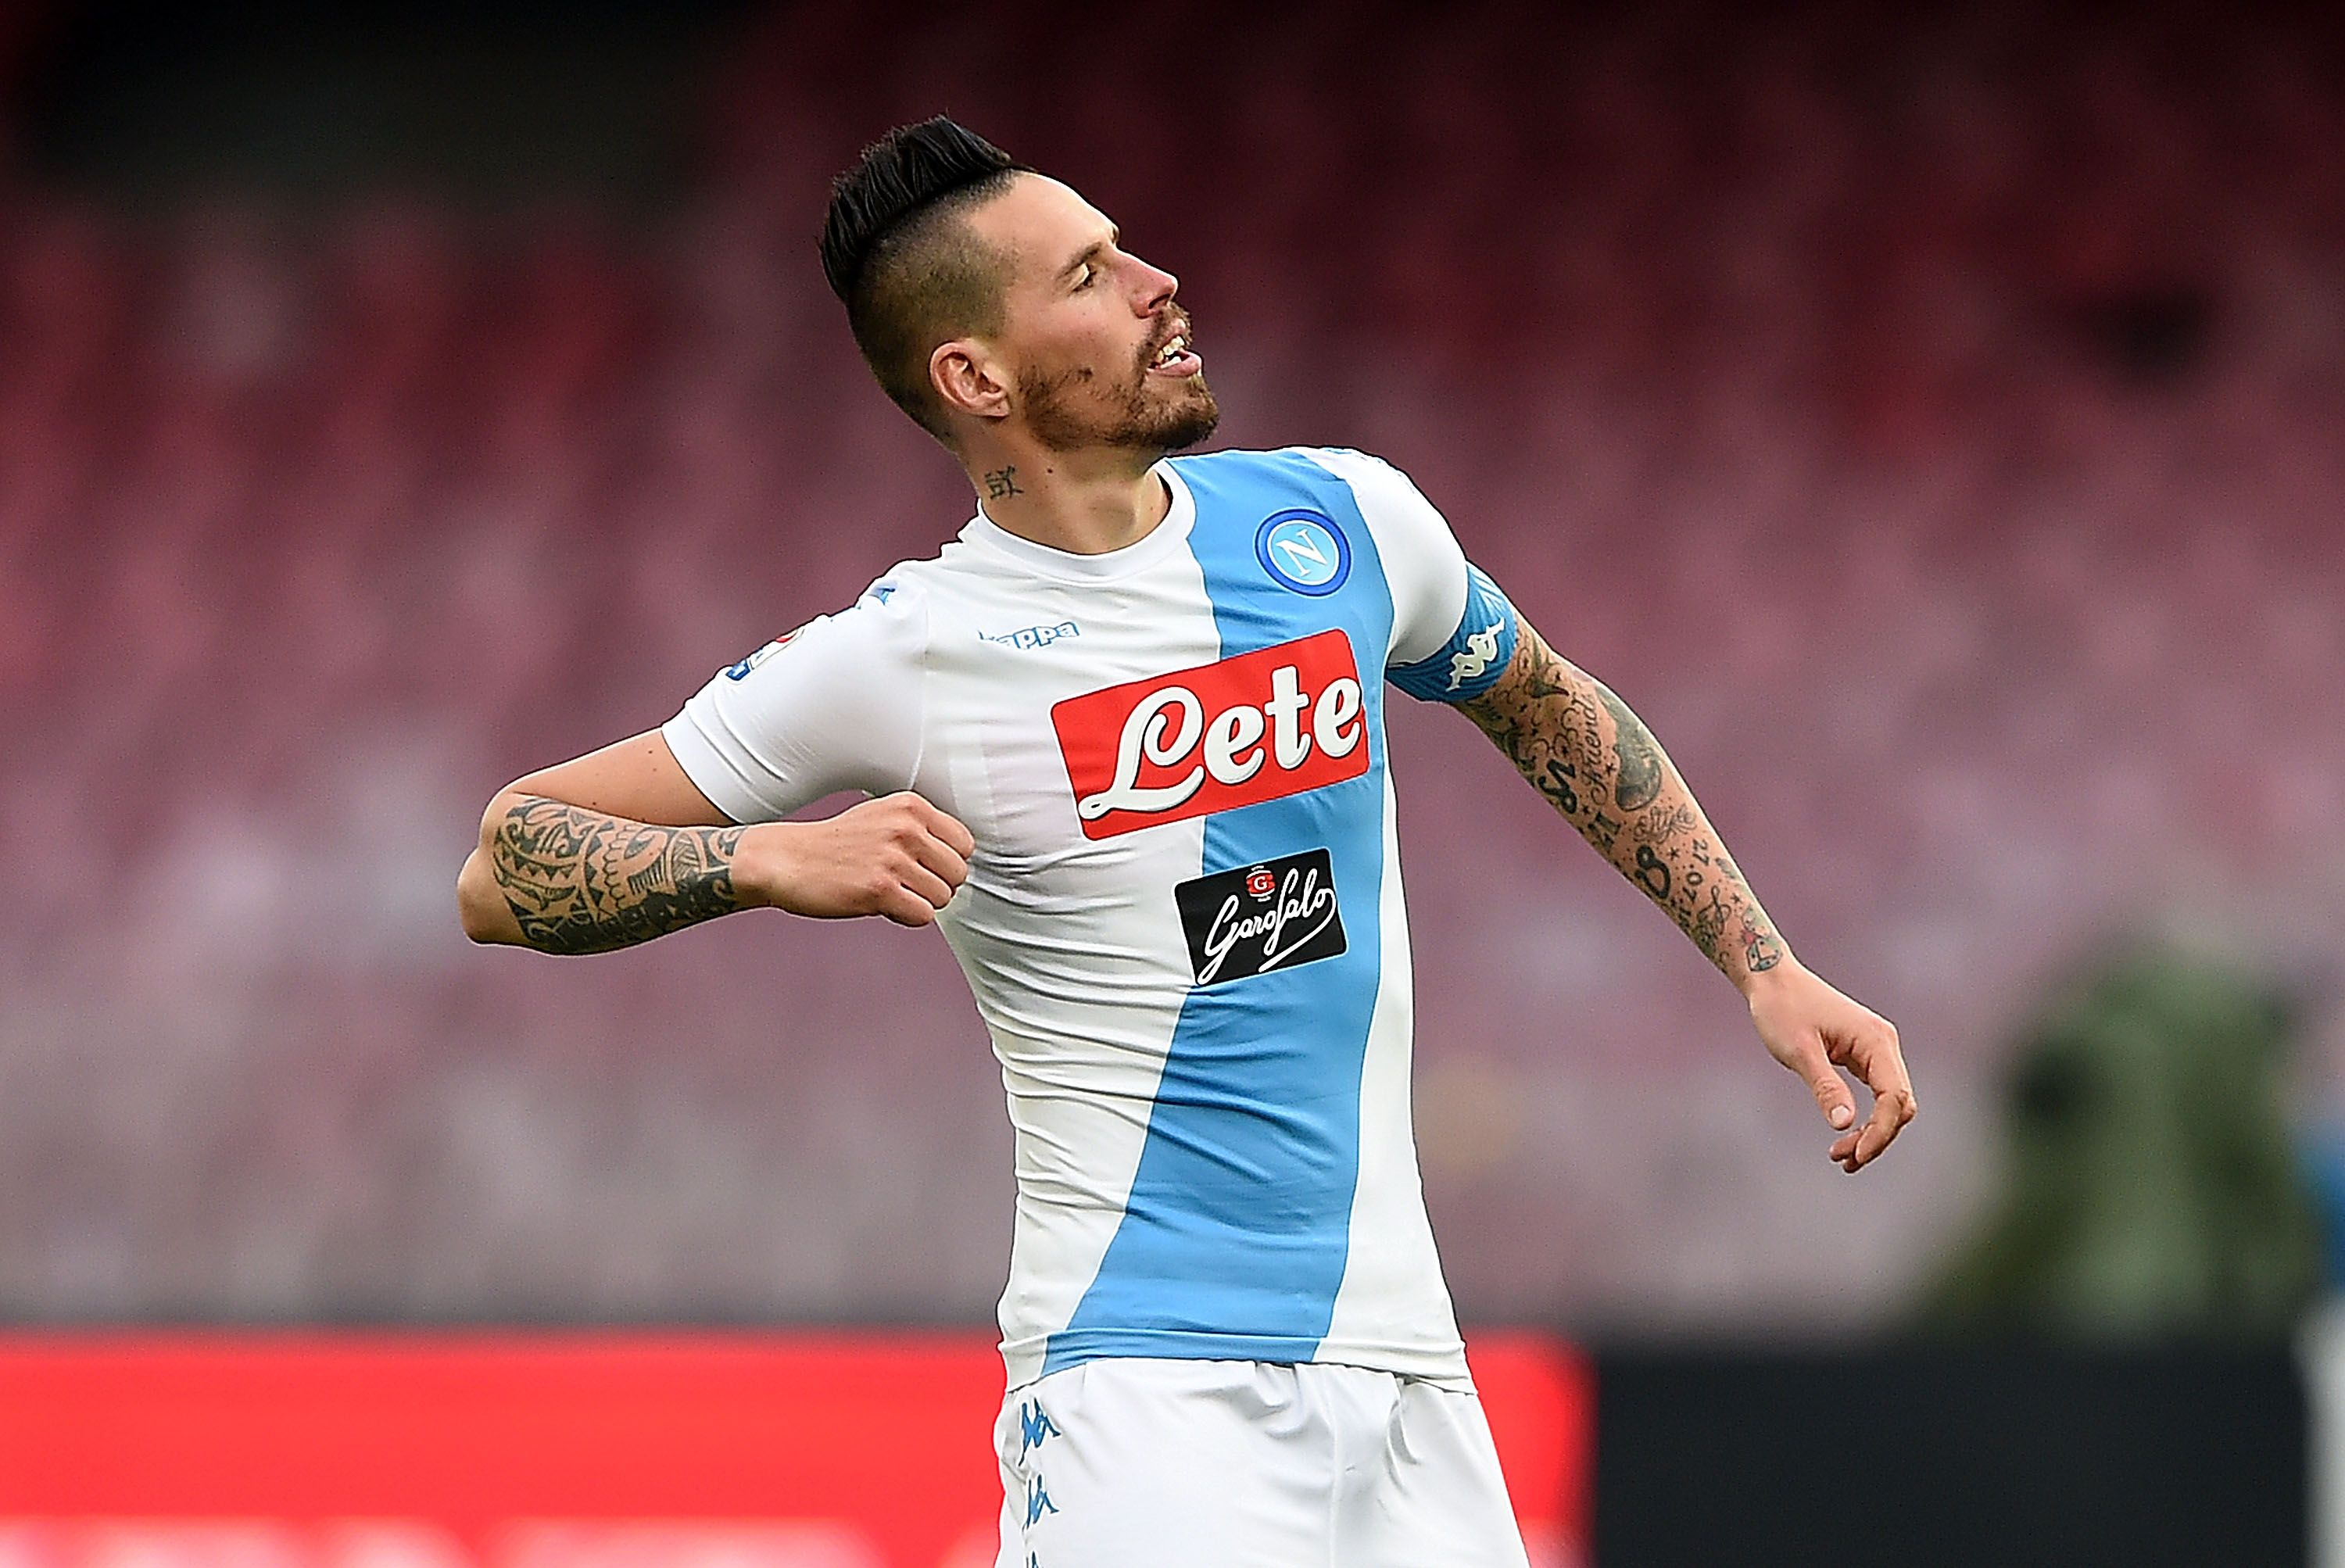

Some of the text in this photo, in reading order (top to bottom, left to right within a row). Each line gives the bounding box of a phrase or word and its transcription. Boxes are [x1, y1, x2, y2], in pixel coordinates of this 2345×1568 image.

[1275, 528, 1328, 578] N
[1078, 664, 1362, 821] Lete
[1254, 876, 1268, 890] G
[1197, 867, 1337, 985] Garofalo
